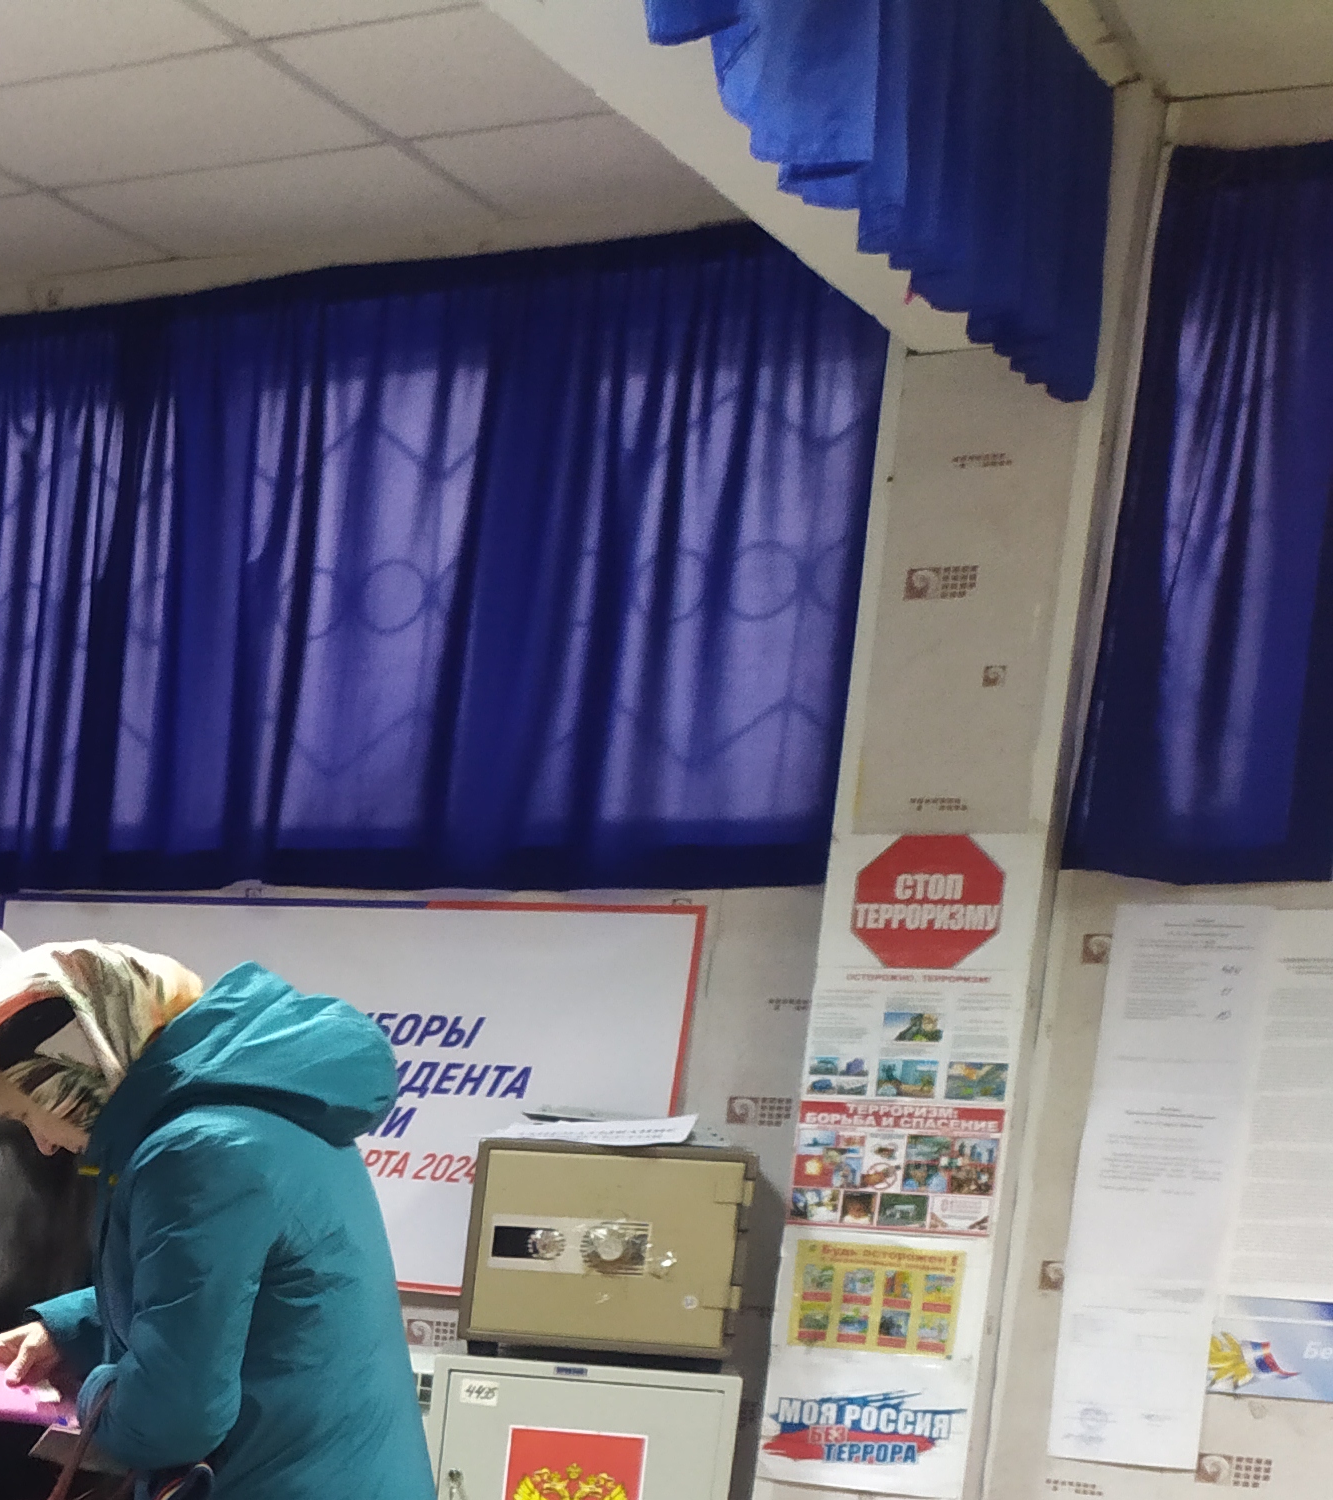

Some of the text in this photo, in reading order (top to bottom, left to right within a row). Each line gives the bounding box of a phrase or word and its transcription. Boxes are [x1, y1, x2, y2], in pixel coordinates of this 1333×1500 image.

[894, 873, 964, 901] СТОП
[854, 903, 1001, 931] ТЕРРОРИЗМУ
[366, 1012, 486, 1049] БОРЫ
[397, 1060, 533, 1100] ИДЕНТА
[805, 1112, 999, 1132] БОРЬБА И СПАСЕНИЕ
[846, 1103, 958, 1118] ТЕРРОРИЗМ:
[364, 1149, 411, 1179] РТА
[778, 1397, 952, 1440] МОЯ РОССИЯ
[808, 1425, 849, 1444] БЕЗ
[824, 1444, 918, 1465] ТЕРРОРА
